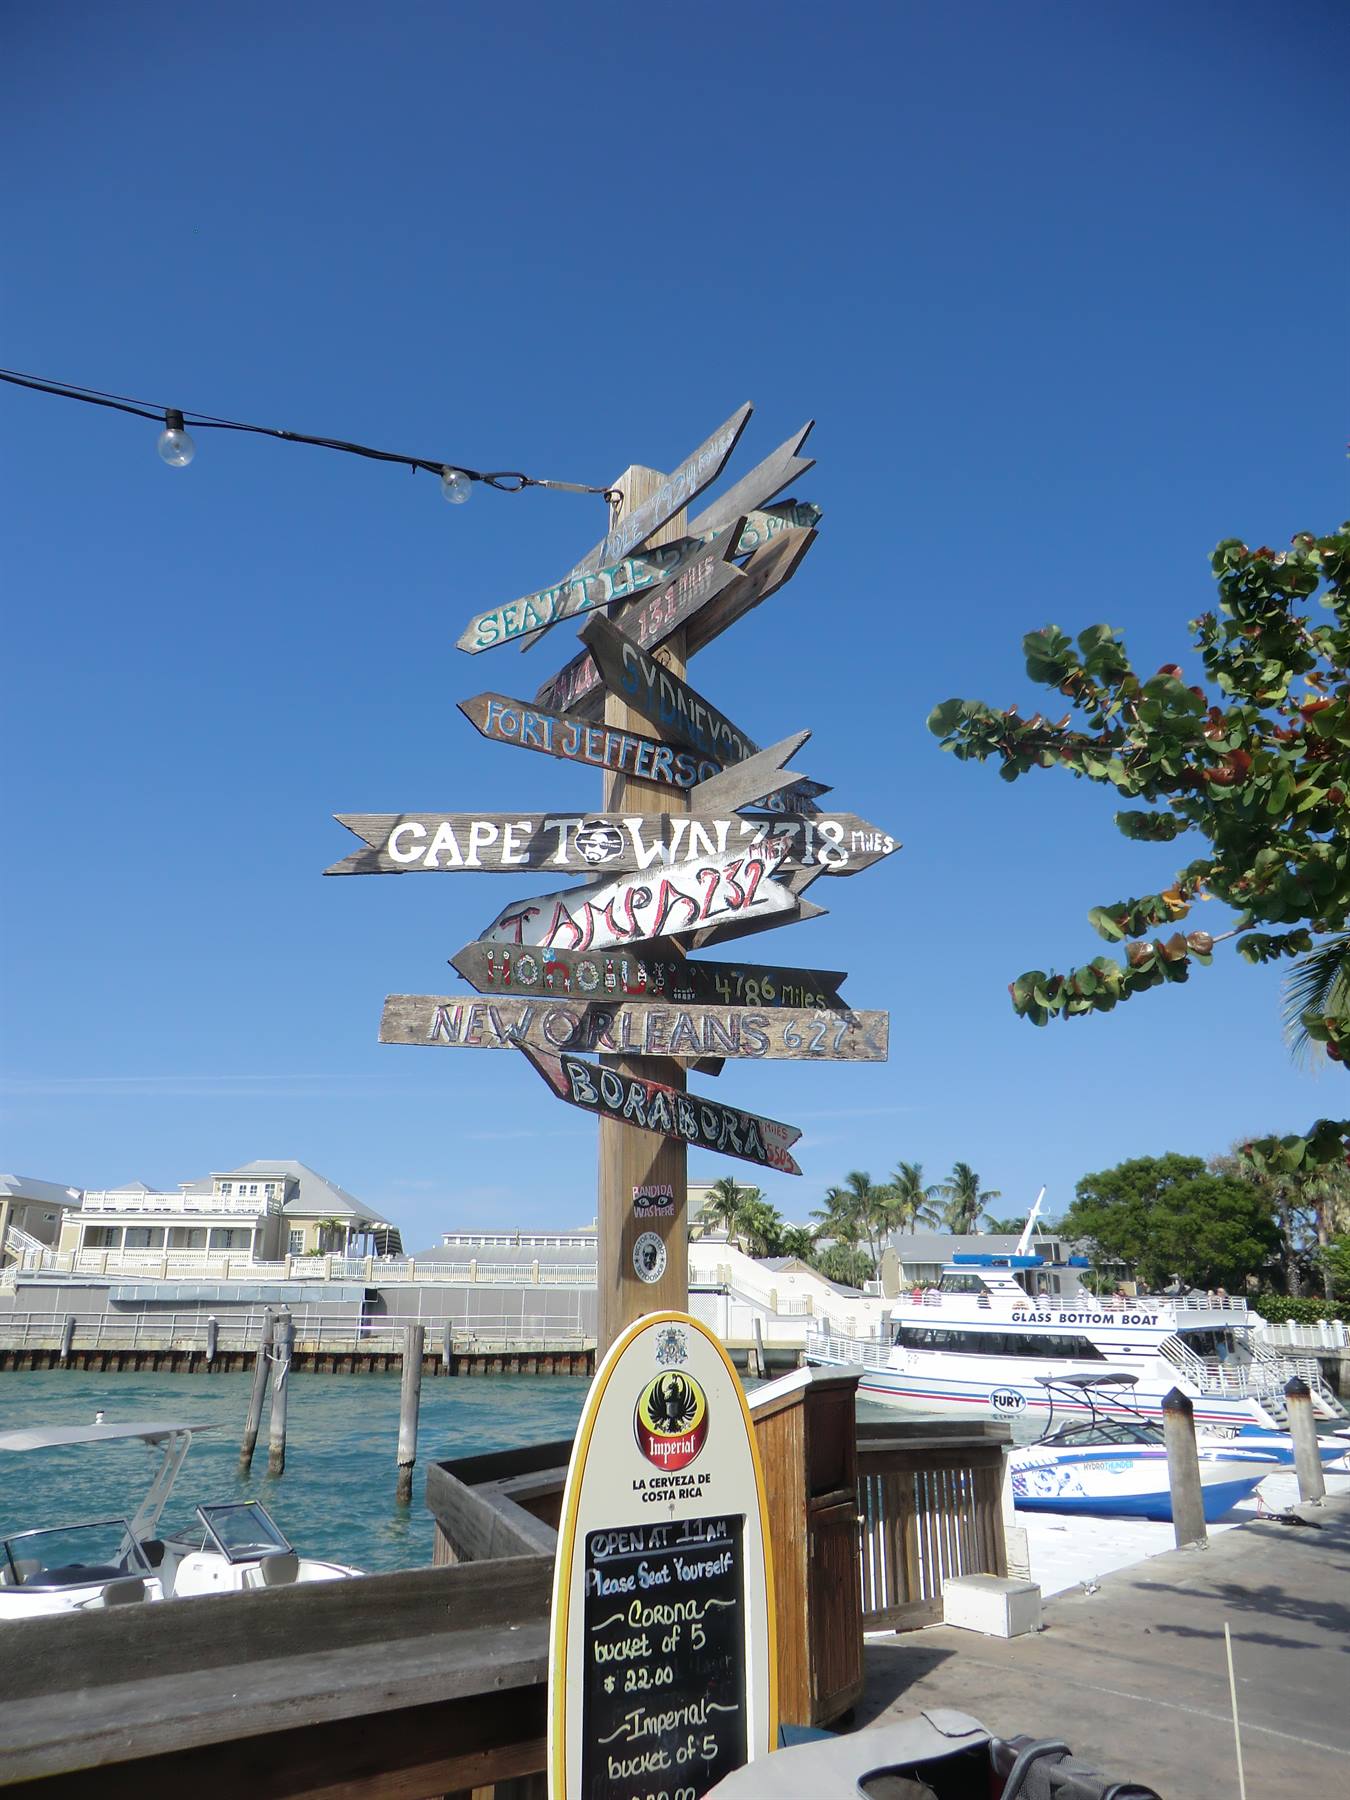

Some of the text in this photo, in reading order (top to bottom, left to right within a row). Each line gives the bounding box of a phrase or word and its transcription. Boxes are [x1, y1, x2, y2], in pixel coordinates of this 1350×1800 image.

[475, 556, 655, 648] SEATTLE
[620, 643, 722, 757] SYDNEY
[485, 699, 555, 752] FORT
[562, 720, 727, 788] JEFFERSO
[388, 821, 533, 867] CAPE
[545, 818, 731, 870] TOWN
[499, 878, 700, 952] TAMPA
[695, 859, 769, 921] 232
[428, 1003, 849, 1057] NEW ORLEANS 627
[1011, 1312, 1159, 1326] GLASS BOTTOM BOAT
[993, 1394, 1023, 1408] FURY
[648, 1434, 696, 1464] Imperial
[632, 1473, 711, 1490] LA CERVEZA DE
[642, 1487, 703, 1502] COSTA RICA
[590, 1528, 644, 1557] OPEN
[648, 1526, 673, 1548] AT
[585, 1552, 734, 1596] Please Seat Yourself
[594, 1624, 706, 1663] bucket of 5
[624, 1699, 707, 1741] Imperial
[608, 1735, 718, 1779] bucket of 5
